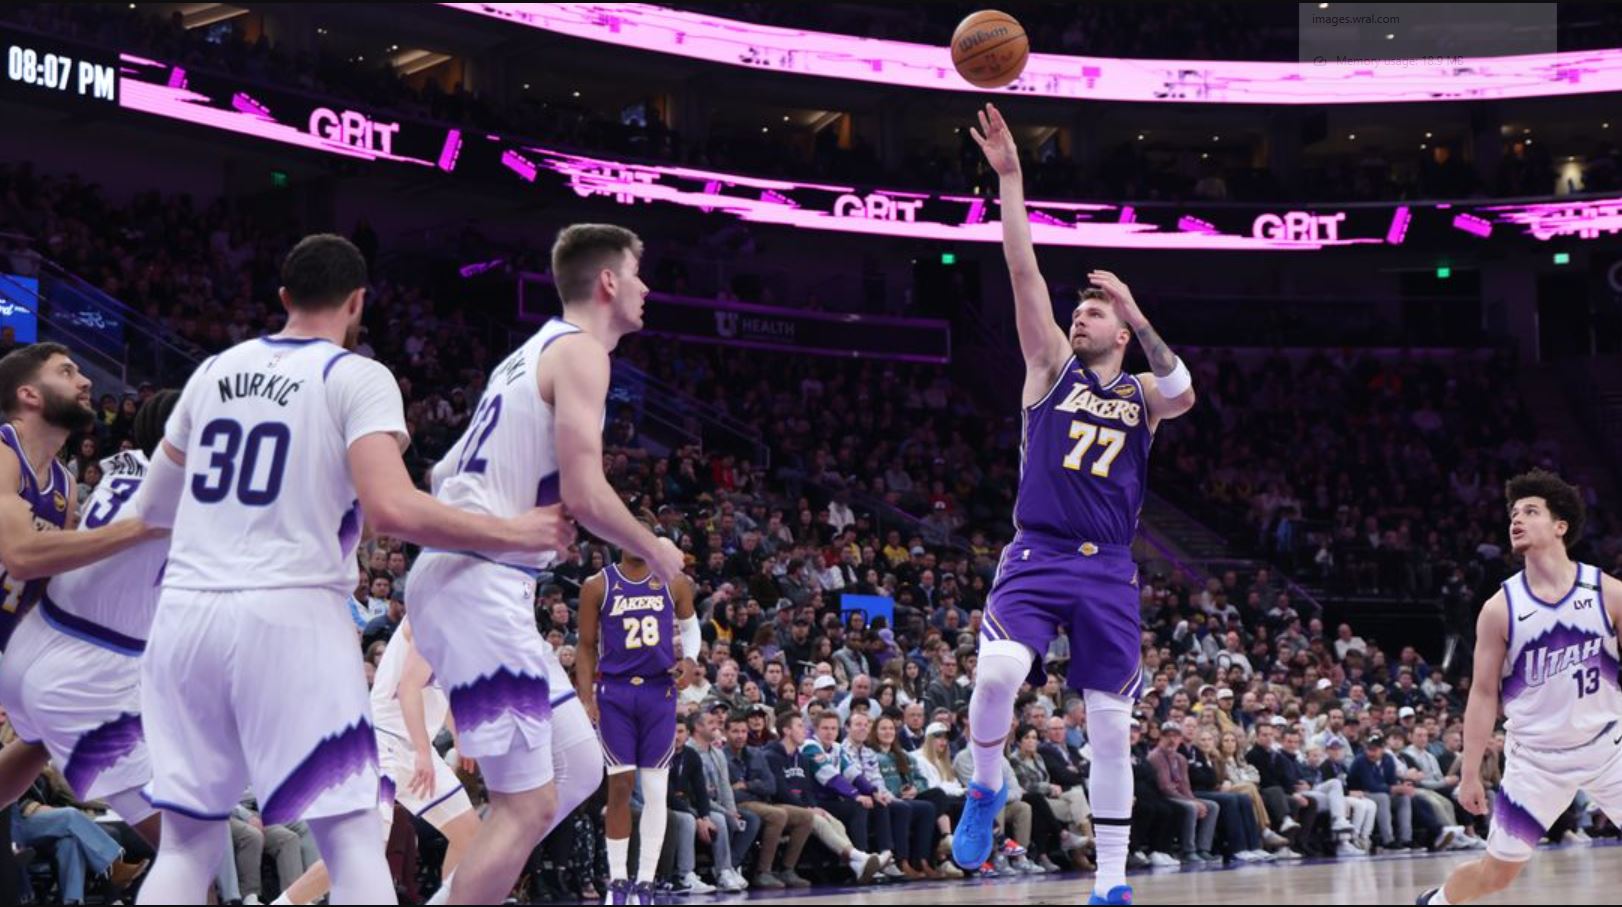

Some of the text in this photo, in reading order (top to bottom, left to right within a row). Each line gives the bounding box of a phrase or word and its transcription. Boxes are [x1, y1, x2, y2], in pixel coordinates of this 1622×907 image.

[8, 45, 115, 101] 08:07 PM
[308, 107, 400, 156] GRIT
[833, 193, 923, 224] GRIT
[1252, 211, 1346, 241] GRIT
[742, 318, 795, 336] HEALTH
[218, 372, 304, 407] NURKIĆ
[1054, 382, 1141, 428] LAKERS
[190, 417, 292, 507] 30
[1062, 419, 1127, 478] 77
[85, 477, 143, 529] 3
[608, 594, 665, 617] LAKERS
[622, 615, 660, 650] 28
[1524, 636, 1604, 688] UTAH
[1572, 666, 1600, 699] 13
